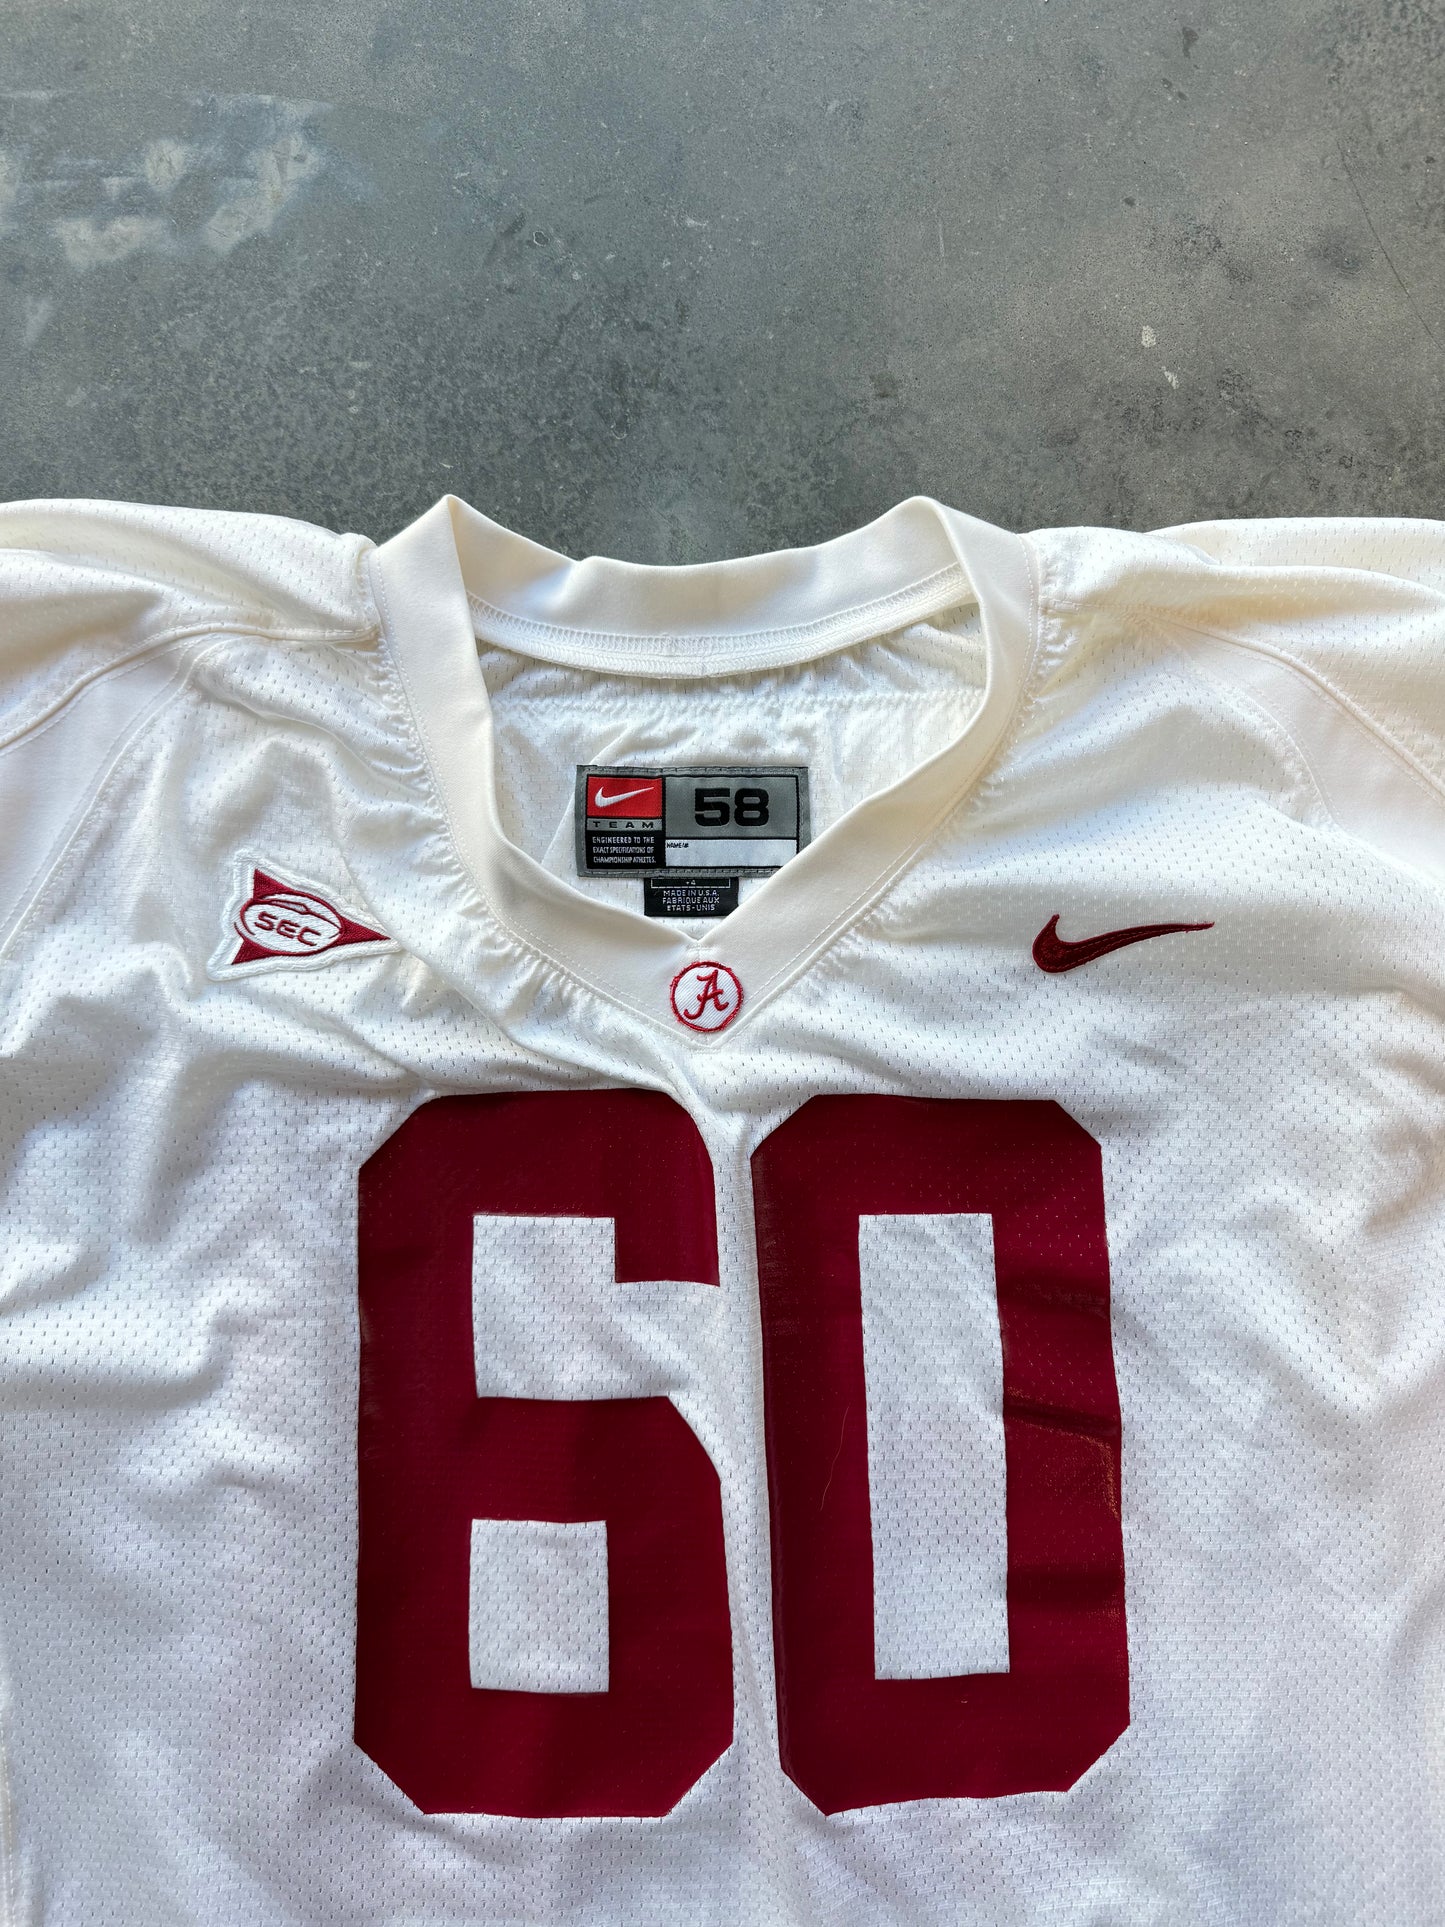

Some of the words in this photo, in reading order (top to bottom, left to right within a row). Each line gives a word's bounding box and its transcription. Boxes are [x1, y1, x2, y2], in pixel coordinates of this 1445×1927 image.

[695, 788, 769, 826] 58
[592, 821, 654, 829] TEAM
[592, 836, 632, 844] ENGINEERED
[633, 836, 641, 844] TO
[643, 836, 655, 844] THE
[592, 846, 609, 854] EXACT
[609, 846, 646, 854] SPECIFICATIONS
[646, 846, 655, 854] OF
[593, 856, 632, 864] CHAMPIONSHIP
[632, 856, 657, 864] ATHLETES.
[663, 889, 686, 897] MADE
[687, 889, 697, 897] IN
[697, 889, 720, 897] U.S.A.
[662, 896, 701, 904] FABRIQUE
[702, 896, 720, 904] AUX
[254, 910, 322, 947] SEC
[683, 969, 730, 1020] A
[354, 1088, 1130, 1819] 60
